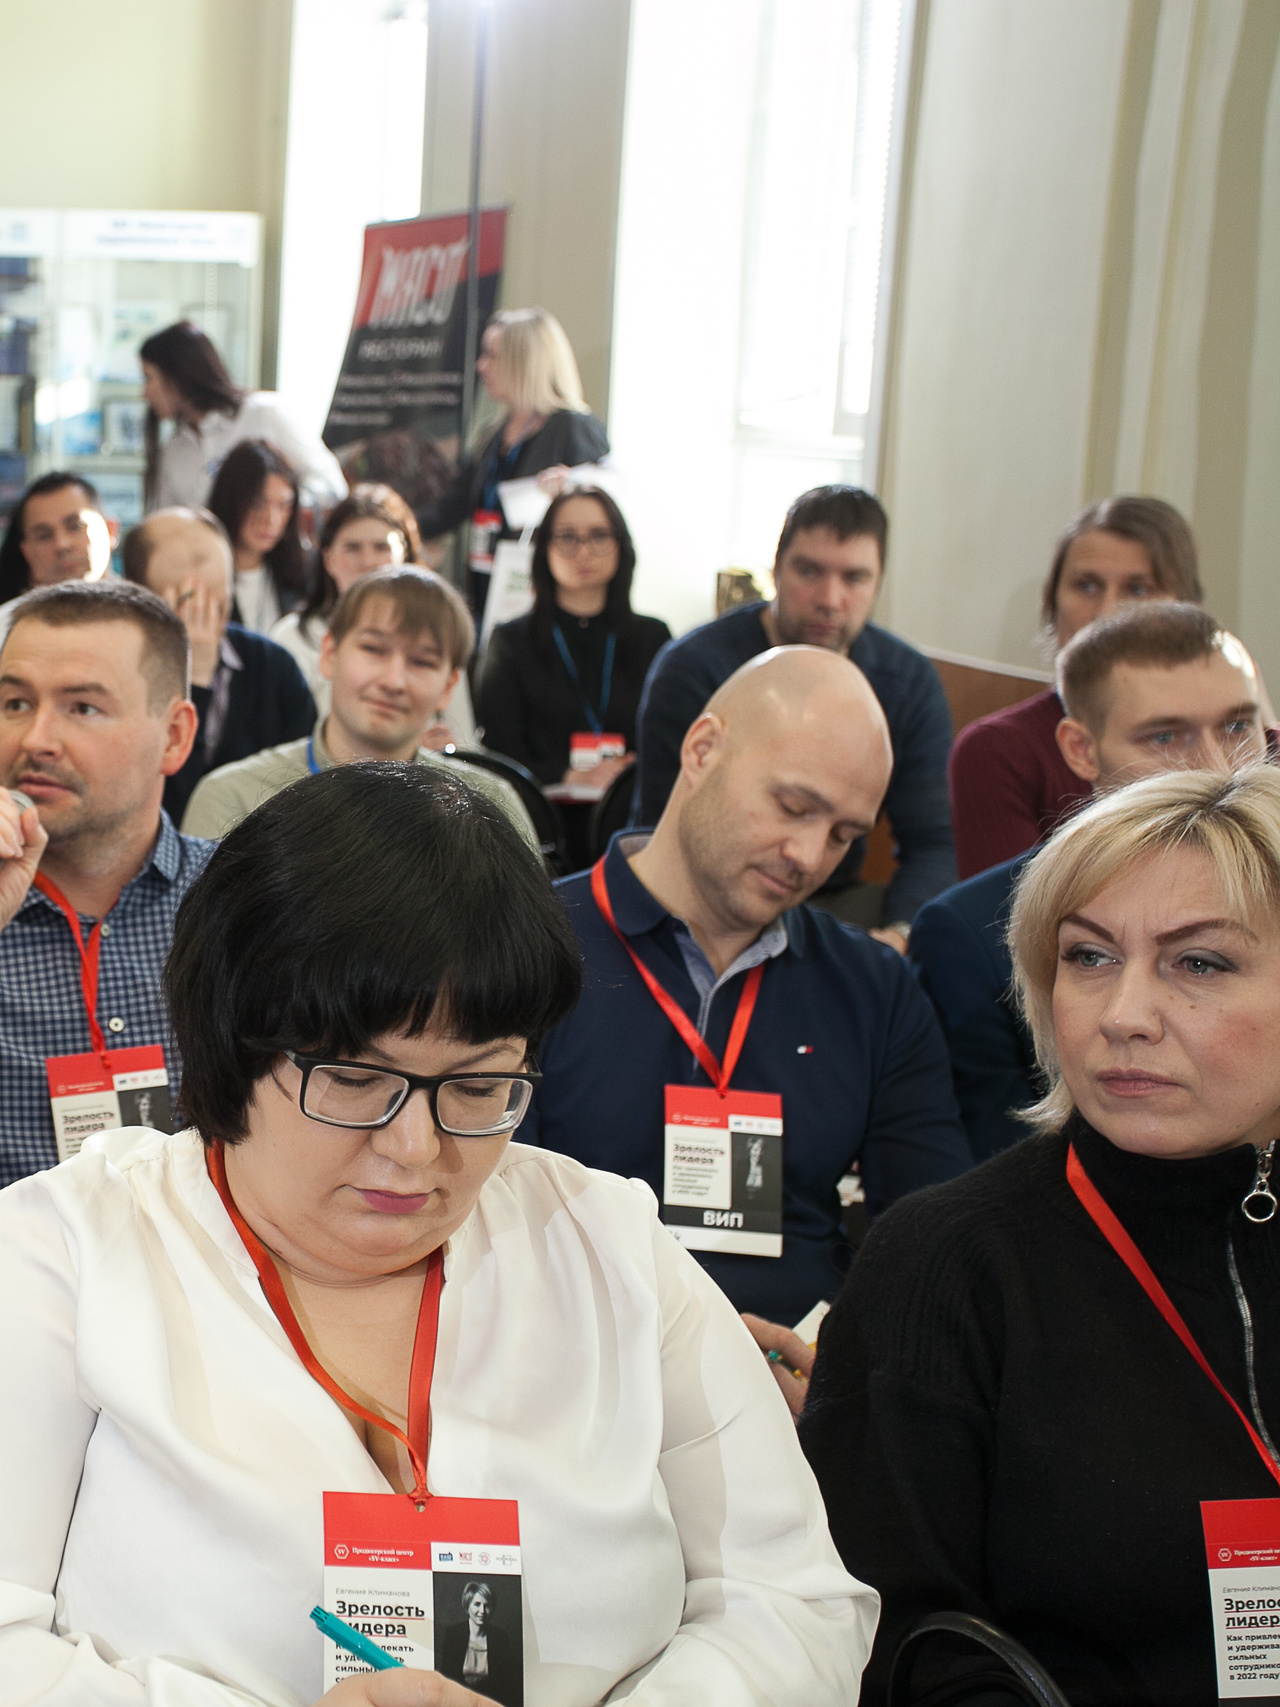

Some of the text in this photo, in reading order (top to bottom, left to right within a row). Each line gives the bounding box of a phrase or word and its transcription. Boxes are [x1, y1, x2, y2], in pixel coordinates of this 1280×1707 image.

[62, 1111, 115, 1124] Зрелость
[673, 1143, 726, 1156] Зрелость
[703, 1209, 744, 1228] ВИП
[335, 1587, 411, 1598] Евгения Климанова
[1222, 1586, 1251, 1594] Евгения
[336, 1600, 425, 1617] Зрелость
[347, 1621, 407, 1638] идера
[1226, 1634, 1243, 1642] Как
[1227, 1653, 1268, 1661] сильных
